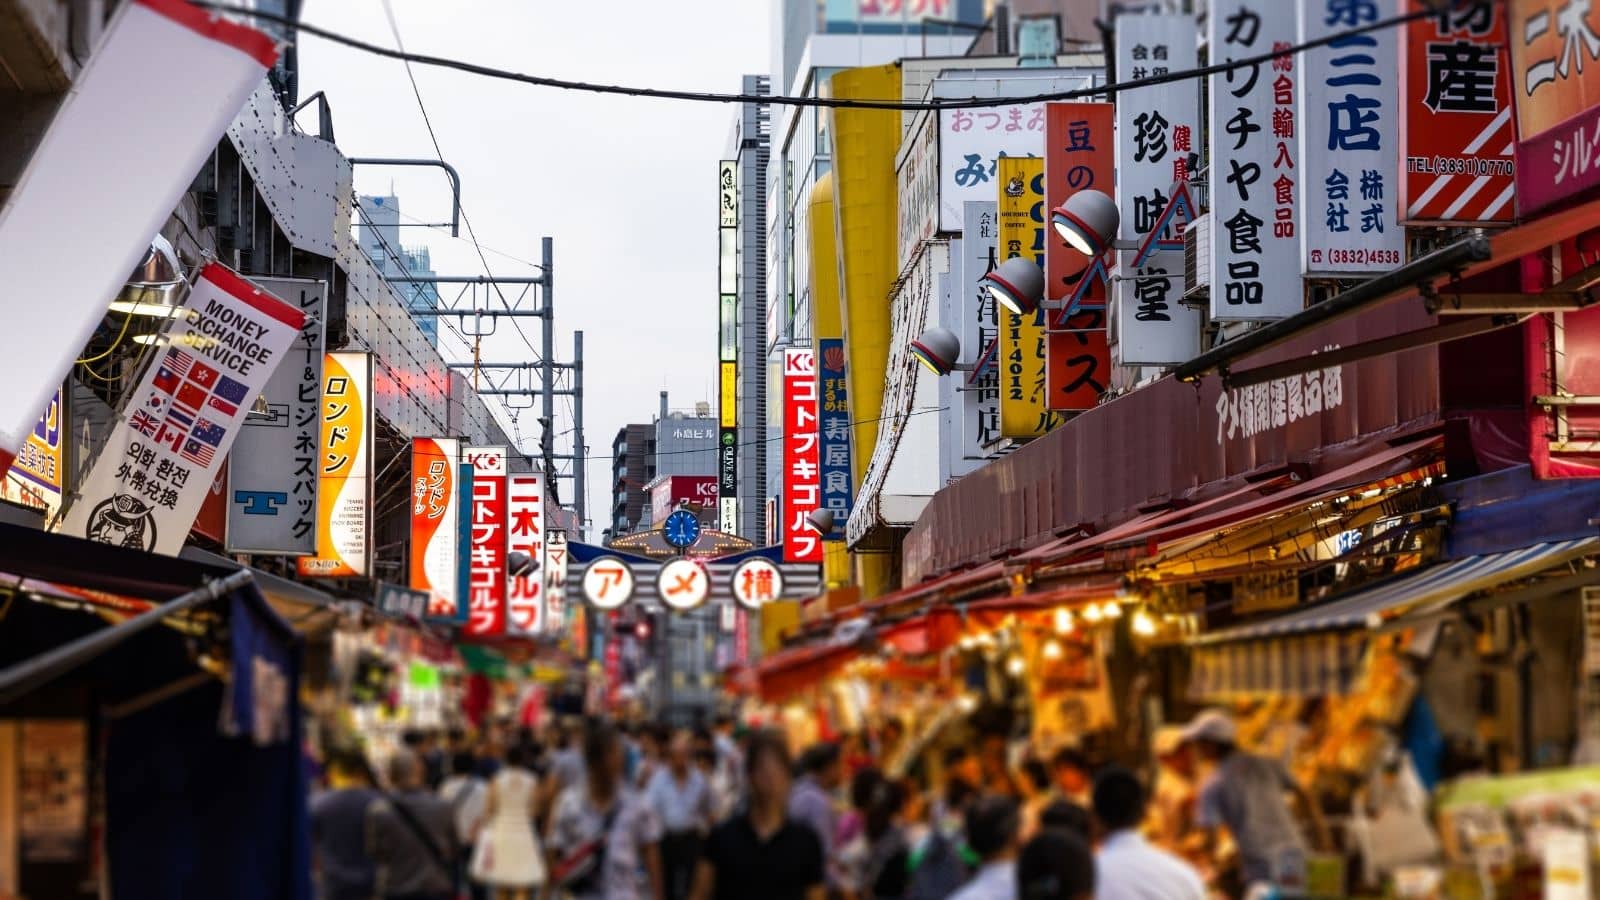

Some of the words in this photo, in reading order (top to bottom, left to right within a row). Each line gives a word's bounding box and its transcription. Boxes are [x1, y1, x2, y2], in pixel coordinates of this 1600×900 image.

[951, 107, 1045, 133] おつまみ
[1407, 156, 1514, 177] TEL(3831)0770
[979, 211, 991, 239] 会社
[1133, 110, 1172, 322] 珍味堂
[1326, 168, 1350, 233] 会社
[1359, 169, 1384, 233] 株式
[1328, 249, 1400, 265] (3832)4538
[185, 308, 273, 365] EXCHANGE
[204, 298, 270, 341] MONEY
[183, 329, 255, 377] SERVICE
[324, 376, 349, 474] ロンドン
[126, 441, 156, 471] 외화
[156, 458, 191, 489] 환전
[428, 461, 446, 519] ロンドン
[791, 380, 819, 558] コトブキゴルフ
[824, 417, 849, 520] 寿屋食品
[472, 480, 501, 633] コトブキゴルフ
[594, 567, 774, 600] アメ横
